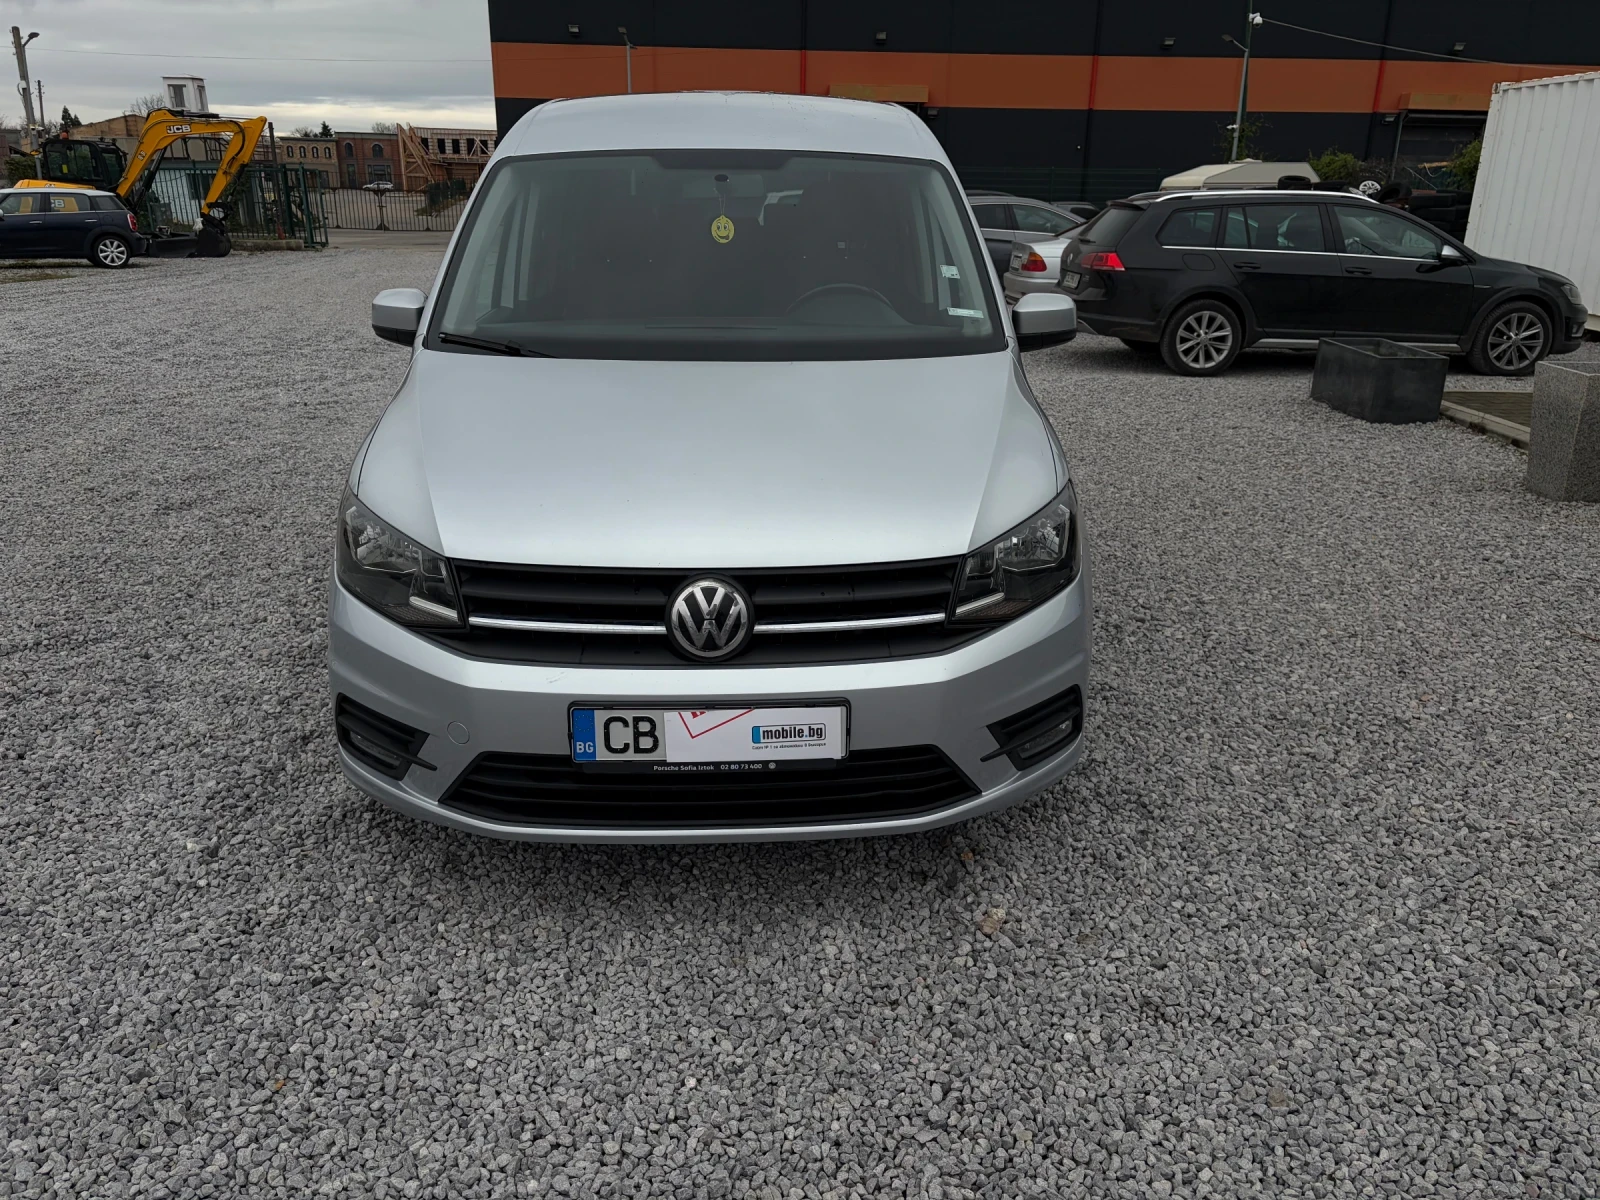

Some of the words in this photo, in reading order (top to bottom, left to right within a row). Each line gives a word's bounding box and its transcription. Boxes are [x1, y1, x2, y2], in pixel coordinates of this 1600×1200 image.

[167, 125, 191, 134] JCB
[762, 726, 823, 740] mobile.bg
[576, 741, 594, 753] BG
